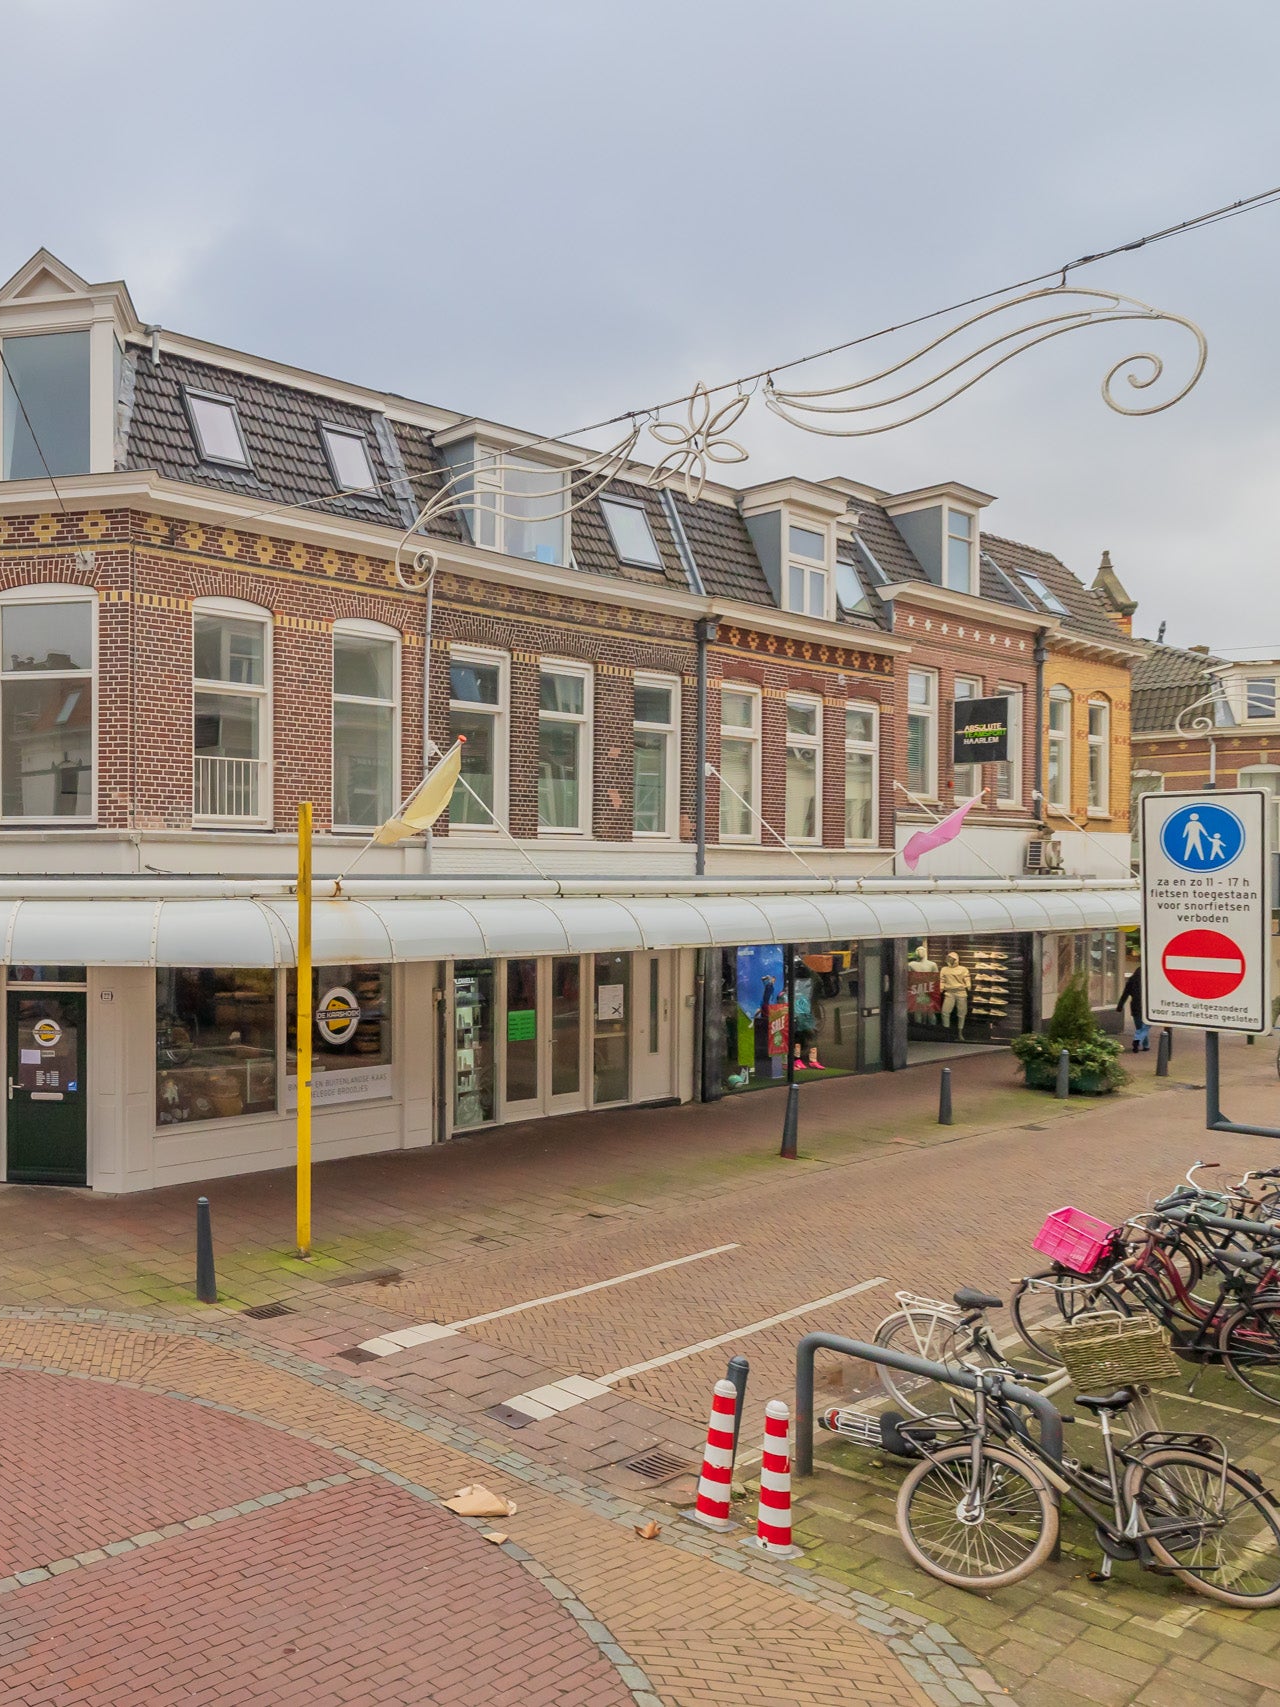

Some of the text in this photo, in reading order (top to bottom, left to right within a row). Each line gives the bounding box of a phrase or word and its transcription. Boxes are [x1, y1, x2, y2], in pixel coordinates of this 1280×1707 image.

[963, 736, 999, 744] HAARLEM
[1206, 878, 1213, 886] 11
[1228, 878, 1239, 886] 17
[1243, 878, 1249, 887] h
[1150, 889, 1257, 901] fietsen toegestaan
[1157, 902, 1250, 911] voor snorfietsen
[1177, 914, 1229, 923] verboden
[911, 981, 935, 995] SALE
[1160, 1000, 1248, 1013] fietsen uitgezonderd
[1171, 1010, 1218, 1020] snorfietsen
[1221, 1014, 1259, 1024] gesloten
[771, 1015, 785, 1035] SALE
[371, 1073, 387, 1081] KAAS
[312, 1088, 335, 1098] ELEGDE
